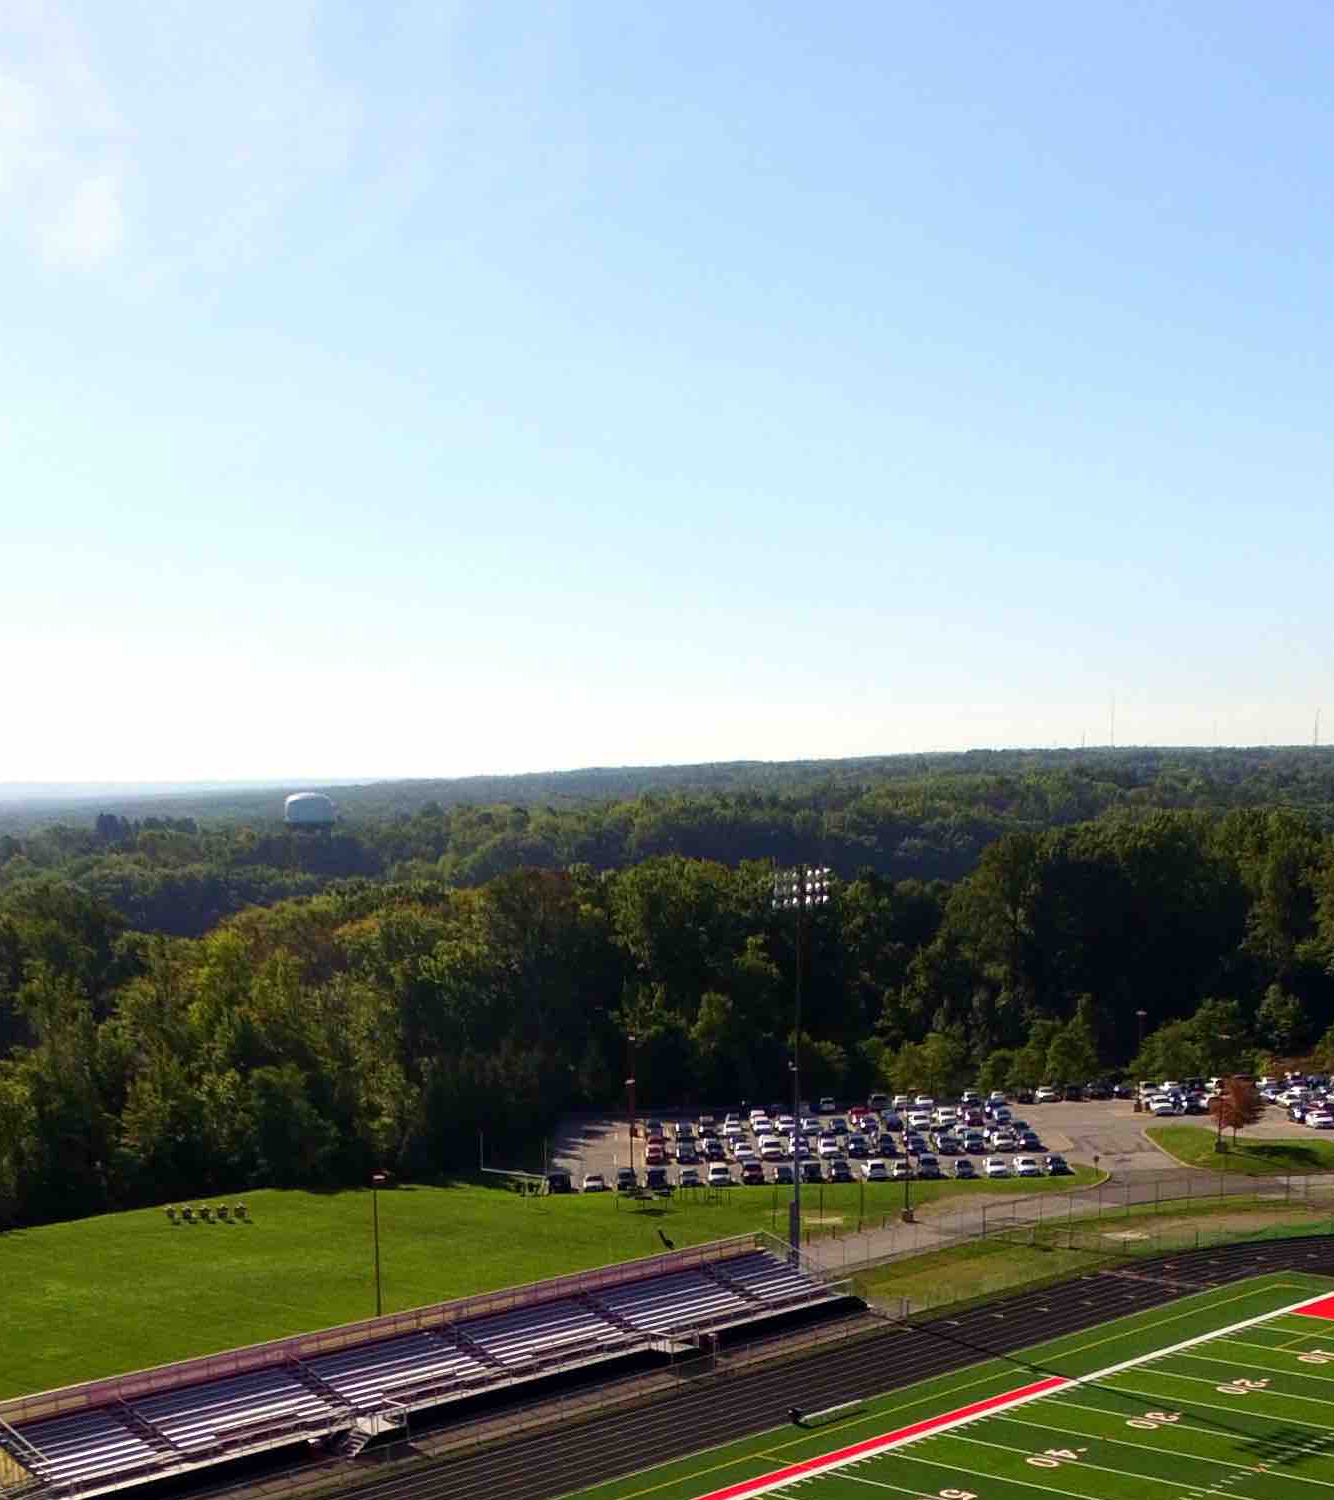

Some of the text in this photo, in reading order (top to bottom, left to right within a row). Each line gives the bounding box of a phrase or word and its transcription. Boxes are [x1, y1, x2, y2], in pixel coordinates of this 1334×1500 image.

[1216, 1378, 1262, 1396] 20
[1125, 1410, 1173, 1431] 30
[1025, 1448, 1079, 1469] 40
